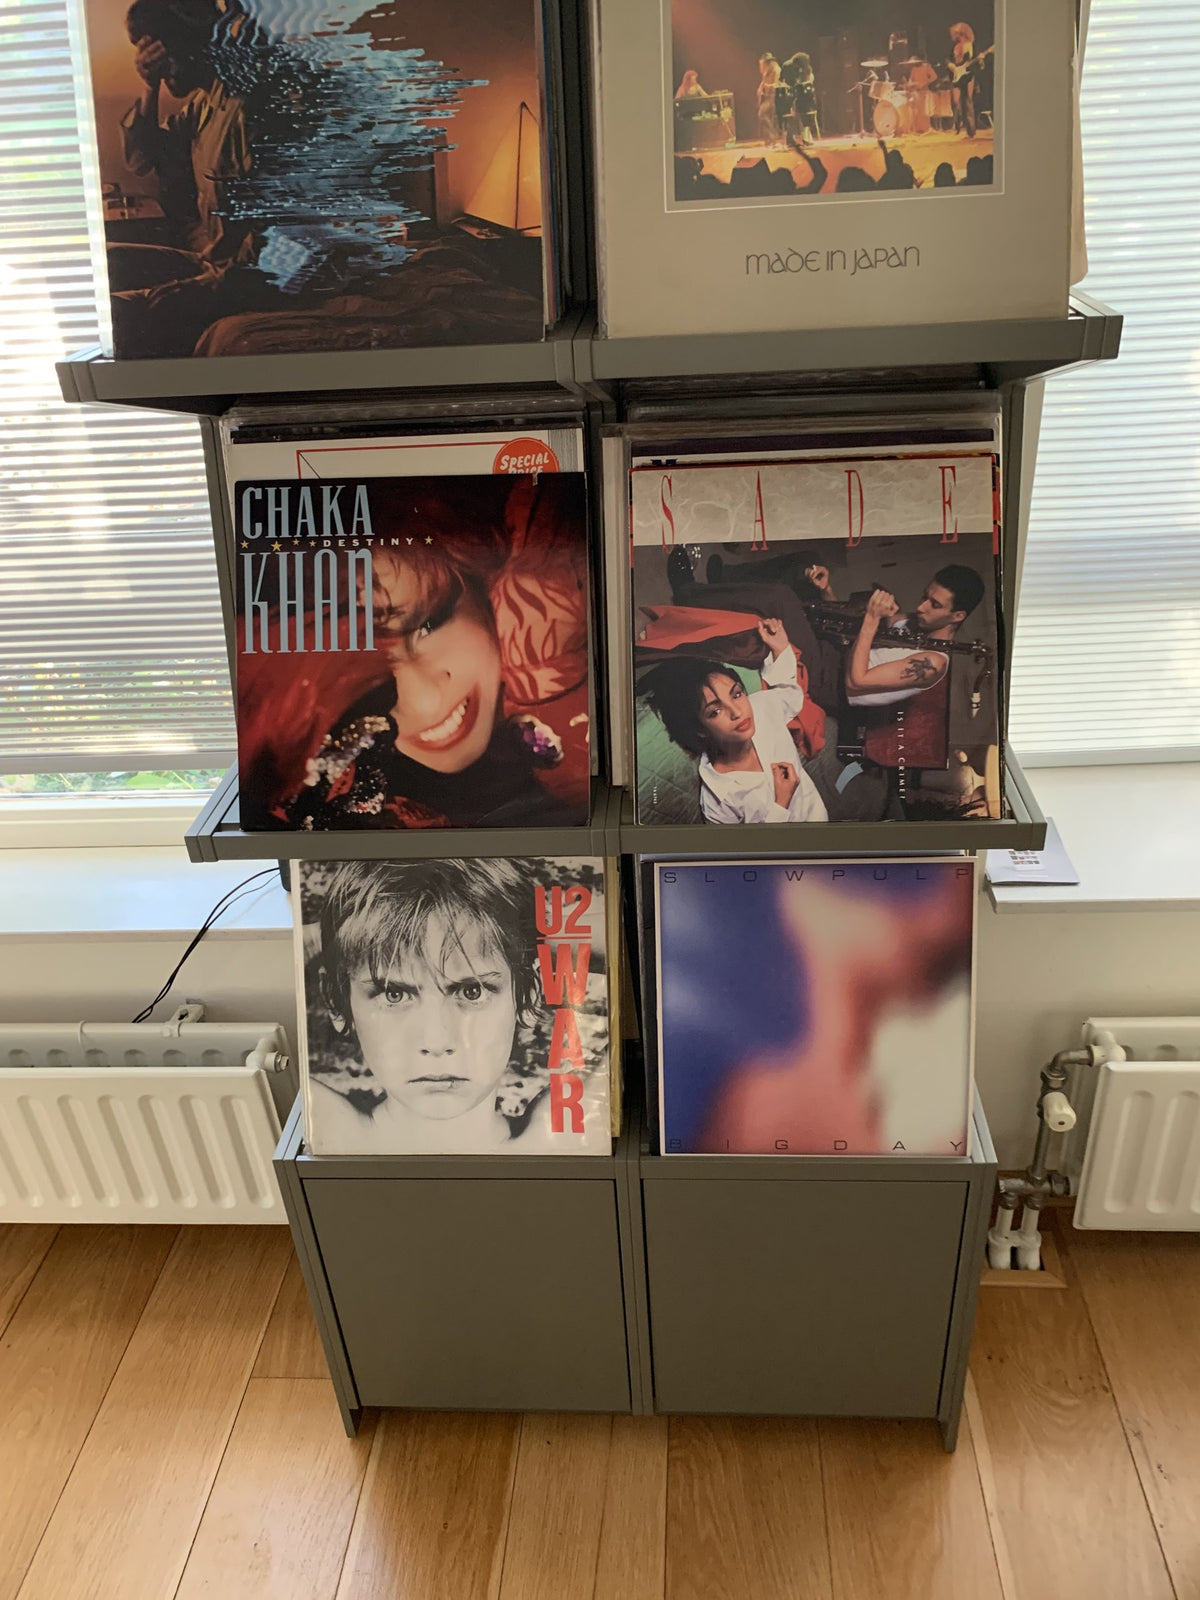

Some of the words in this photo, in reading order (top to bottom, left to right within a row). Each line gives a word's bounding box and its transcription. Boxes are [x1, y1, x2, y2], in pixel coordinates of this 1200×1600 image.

[499, 451, 550, 471] SPECIAL
[241, 484, 376, 540] CHAKA
[659, 464, 960, 554] SADE
[322, 537, 414, 548] DESTINY
[896, 711, 904, 722] IS
[897, 728, 905, 738] IT
[534, 885, 592, 935] U2
[536, 943, 592, 1134] WAR
